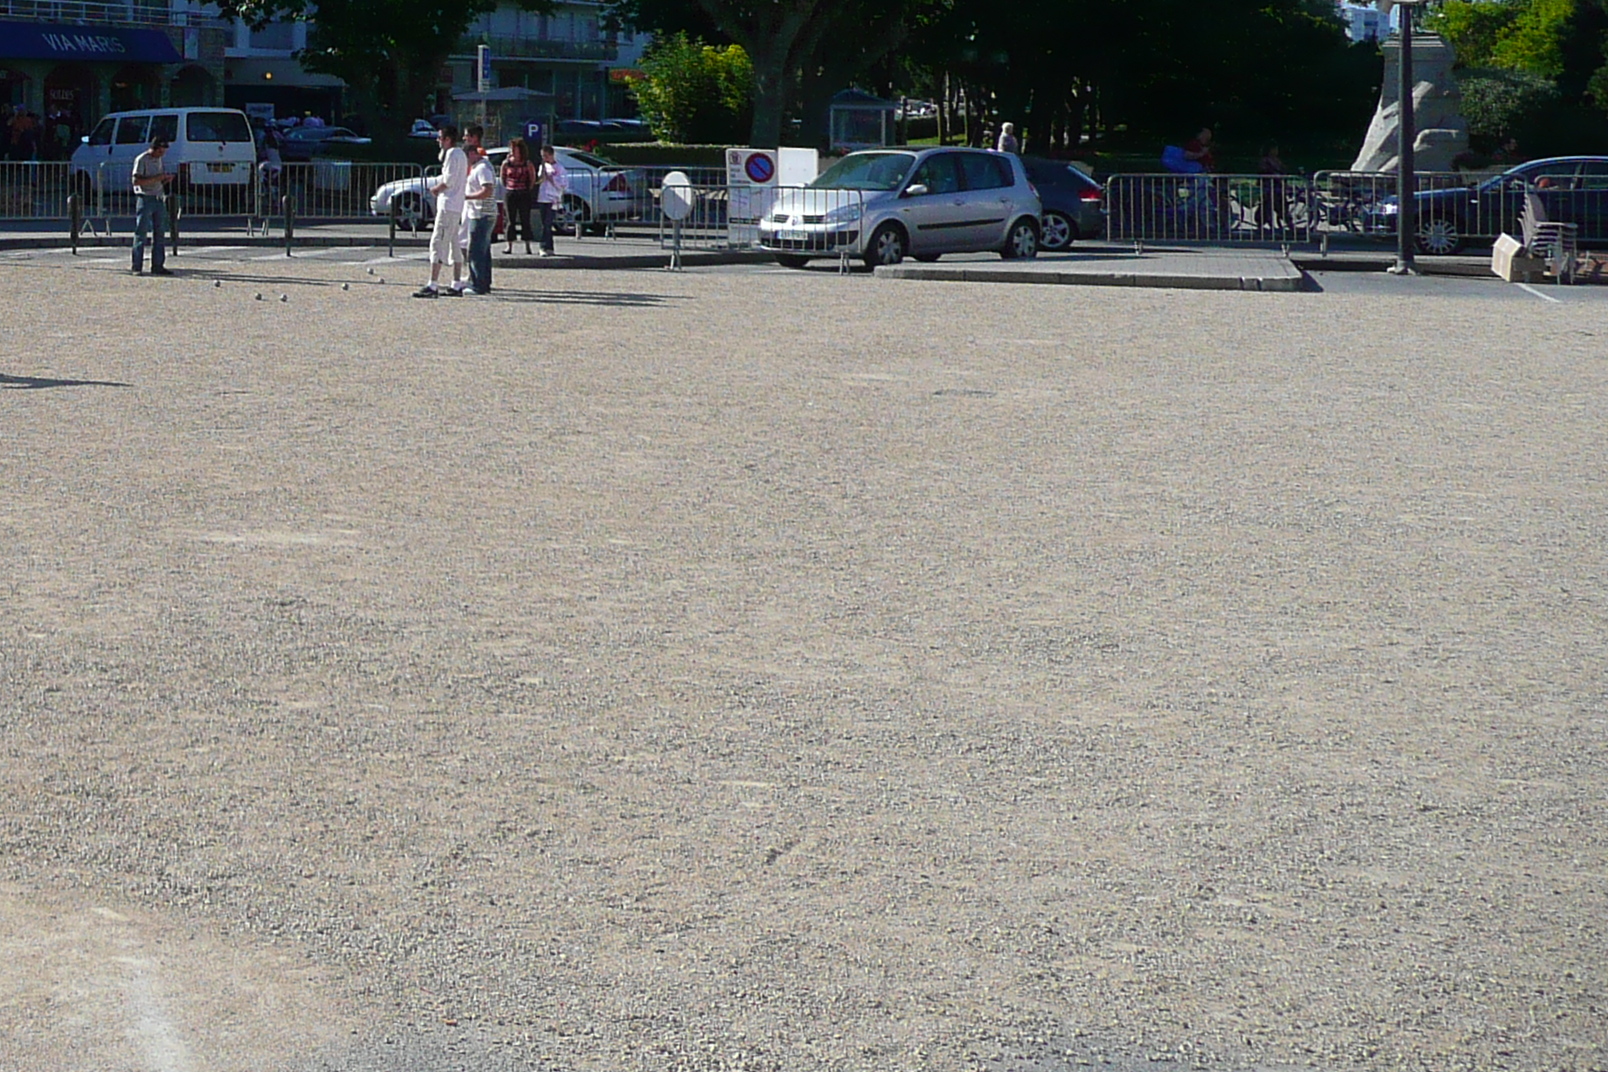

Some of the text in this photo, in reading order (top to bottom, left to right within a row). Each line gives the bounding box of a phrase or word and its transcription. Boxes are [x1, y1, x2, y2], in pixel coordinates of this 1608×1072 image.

[41, 33, 126, 54] VIA MARIS
[527, 124, 539, 137] P
